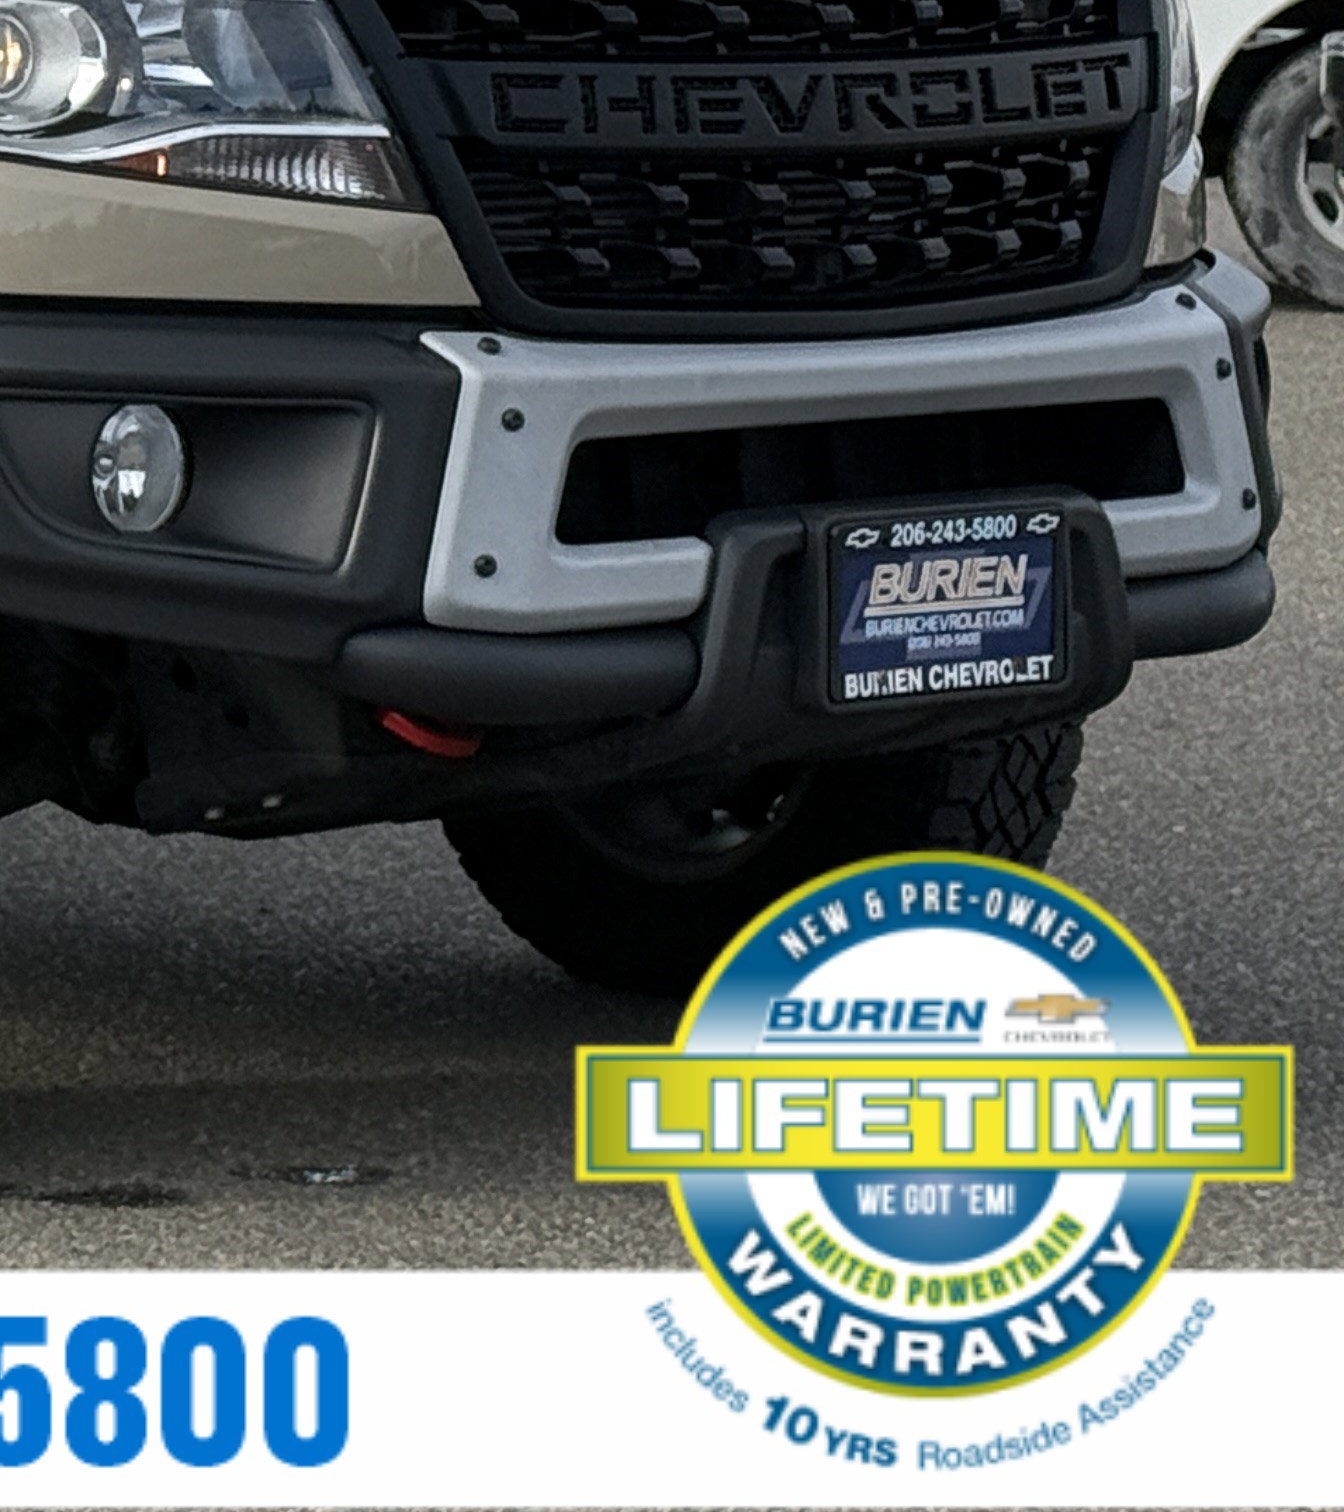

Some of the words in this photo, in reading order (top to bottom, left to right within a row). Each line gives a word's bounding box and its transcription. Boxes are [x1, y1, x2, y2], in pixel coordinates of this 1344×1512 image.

[489, 52, 1131, 136] CHEVROLET
[890, 514, 1018, 548] 206-243-5800
[868, 554, 1029, 605] BURIEN
